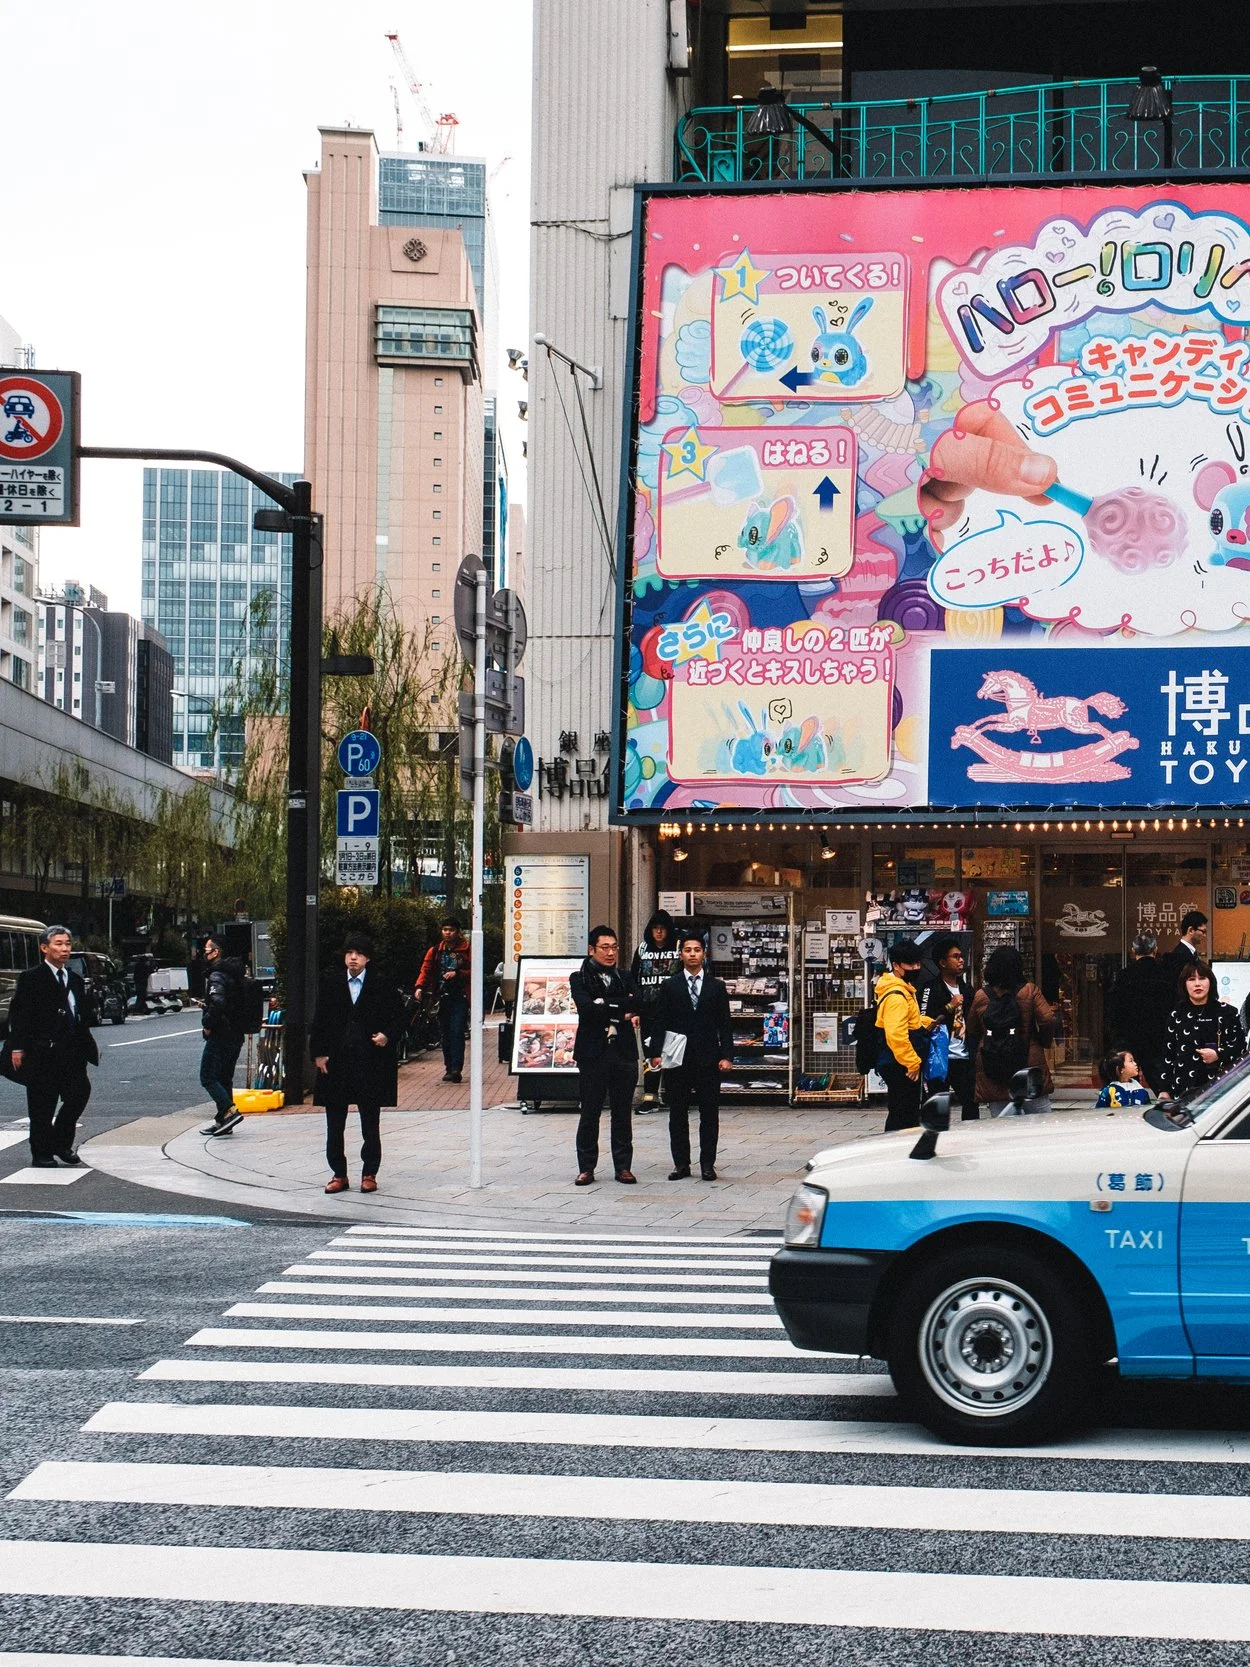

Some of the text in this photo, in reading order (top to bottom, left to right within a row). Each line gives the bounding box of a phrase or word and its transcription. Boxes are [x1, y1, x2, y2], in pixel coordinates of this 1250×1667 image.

[734, 266, 749, 288] 1
[1088, 337, 1245, 372] キャンディ
[681, 443, 697, 464] 3
[659, 613, 733, 658] さらに
[742, 628, 893, 652] 仲良しの2匹が
[348, 744, 364, 771] P
[358, 759, 370, 771] 60
[1160, 759, 1247, 785] TOY
[348, 796, 371, 832] P
[1105, 1230, 1163, 1249] TAXI
